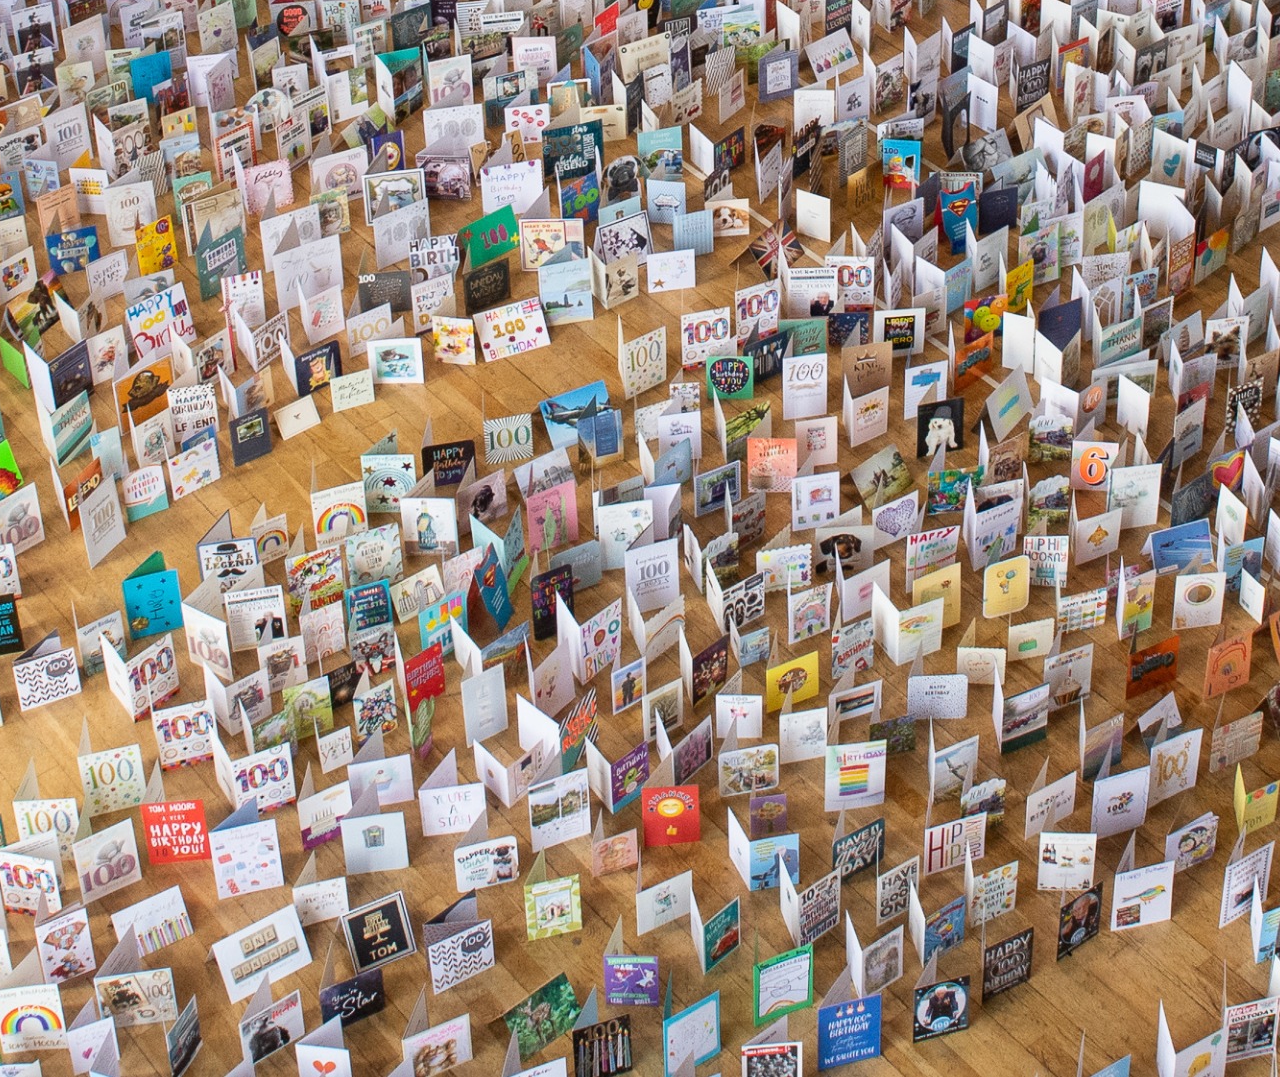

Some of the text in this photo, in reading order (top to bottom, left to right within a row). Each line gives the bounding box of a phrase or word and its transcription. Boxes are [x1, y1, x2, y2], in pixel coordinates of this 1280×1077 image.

[1019, 62, 1049, 80] HAPPY
[56, 124, 84, 141] 100
[883, 146, 899, 156] 100
[489, 173, 526, 183] HAPPY
[119, 195, 140, 209] 100
[410, 235, 458, 252] HAPPY
[480, 223, 508, 247] 100
[410, 249, 459, 267] BIRTH
[358, 274, 376, 285] 100
[128, 290, 175, 322] HAPPY
[485, 305, 519, 322] HAPPY
[736, 288, 779, 321] 100
[351, 317, 388, 344] 100
[885, 316, 914, 326] LEGEND
[682, 316, 729, 347] 100
[887, 335, 914, 346] HERO
[1107, 332, 1137, 348] THANK
[488, 338, 538, 360] BIRTHDAY
[629, 340, 661, 373] 100
[715, 361, 744, 372] HAPPY
[787, 359, 824, 383] 100
[174, 394, 208, 405] HAPPY
[57, 411, 89, 431] THANK
[488, 425, 532, 451] 100
[433, 447, 465, 461] HAPPY
[909, 527, 957, 546] HAPPY
[204, 552, 253, 565] TOTAL
[205, 558, 255, 571] LEGEND
[640, 561, 671, 582] 100
[187, 636, 230, 671] 100
[837, 639, 872, 664] BIRTHDAY
[48, 660, 68, 671] 100
[128, 646, 176, 688] 100
[406, 656, 443, 681] BIRTHDAY
[157, 711, 215, 743] 100
[87, 755, 135, 789] 100
[616, 751, 647, 776] BIRTHDAY
[1158, 746, 1189, 780] 100
[236, 758, 290, 788] 100
[433, 791, 472, 805] YOU'RE
[148, 803, 196, 813] TOM MOORE
[23, 808, 71, 836] 100
[150, 822, 202, 836] HAPPY
[150, 834, 204, 846] BIRTHDAY
[171, 844, 204, 855] YOU!
[836, 830, 867, 853] HAVE
[457, 848, 492, 863] DAPPER
[843, 854, 874, 876] DAY
[0, 862, 56, 895] 100
[81, 853, 138, 896] 100
[882, 862, 918, 890] HAVE
[464, 933, 484, 945] 100
[985, 935, 1030, 962] HAPPY
[369, 943, 398, 961] TOM
[985, 964, 1029, 992] BIRTHDAY
[339, 989, 378, 1017] Star
[584, 1020, 620, 1041] 100
[827, 1018, 852, 1031] HAPPY
[829, 1022, 870, 1038] BIRTHDAY
[836, 1050, 861, 1062] SALUTE
